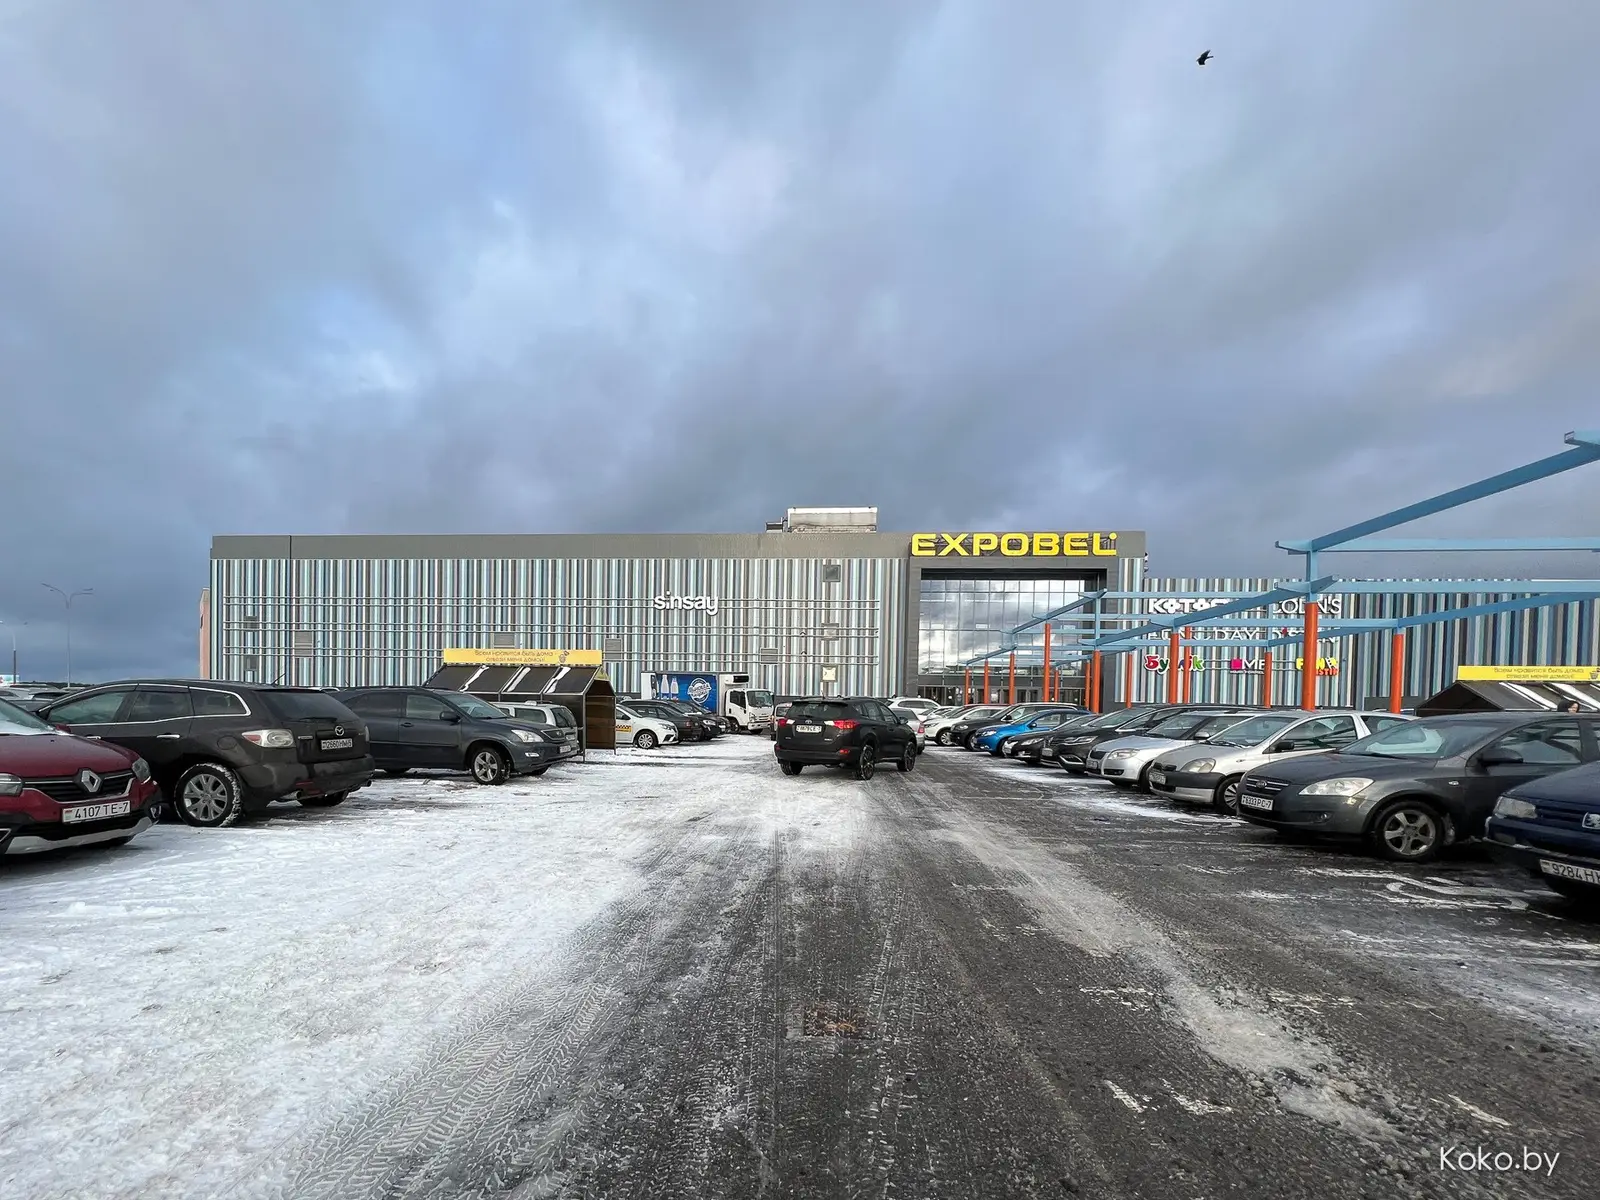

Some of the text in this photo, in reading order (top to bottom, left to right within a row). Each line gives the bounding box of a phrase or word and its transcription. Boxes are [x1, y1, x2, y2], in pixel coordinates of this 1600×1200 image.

[911, 532, 1117, 556] EXPOBEL
[654, 590, 718, 616] sinsay
[75, 802, 129, 818] 4107 TE-7
